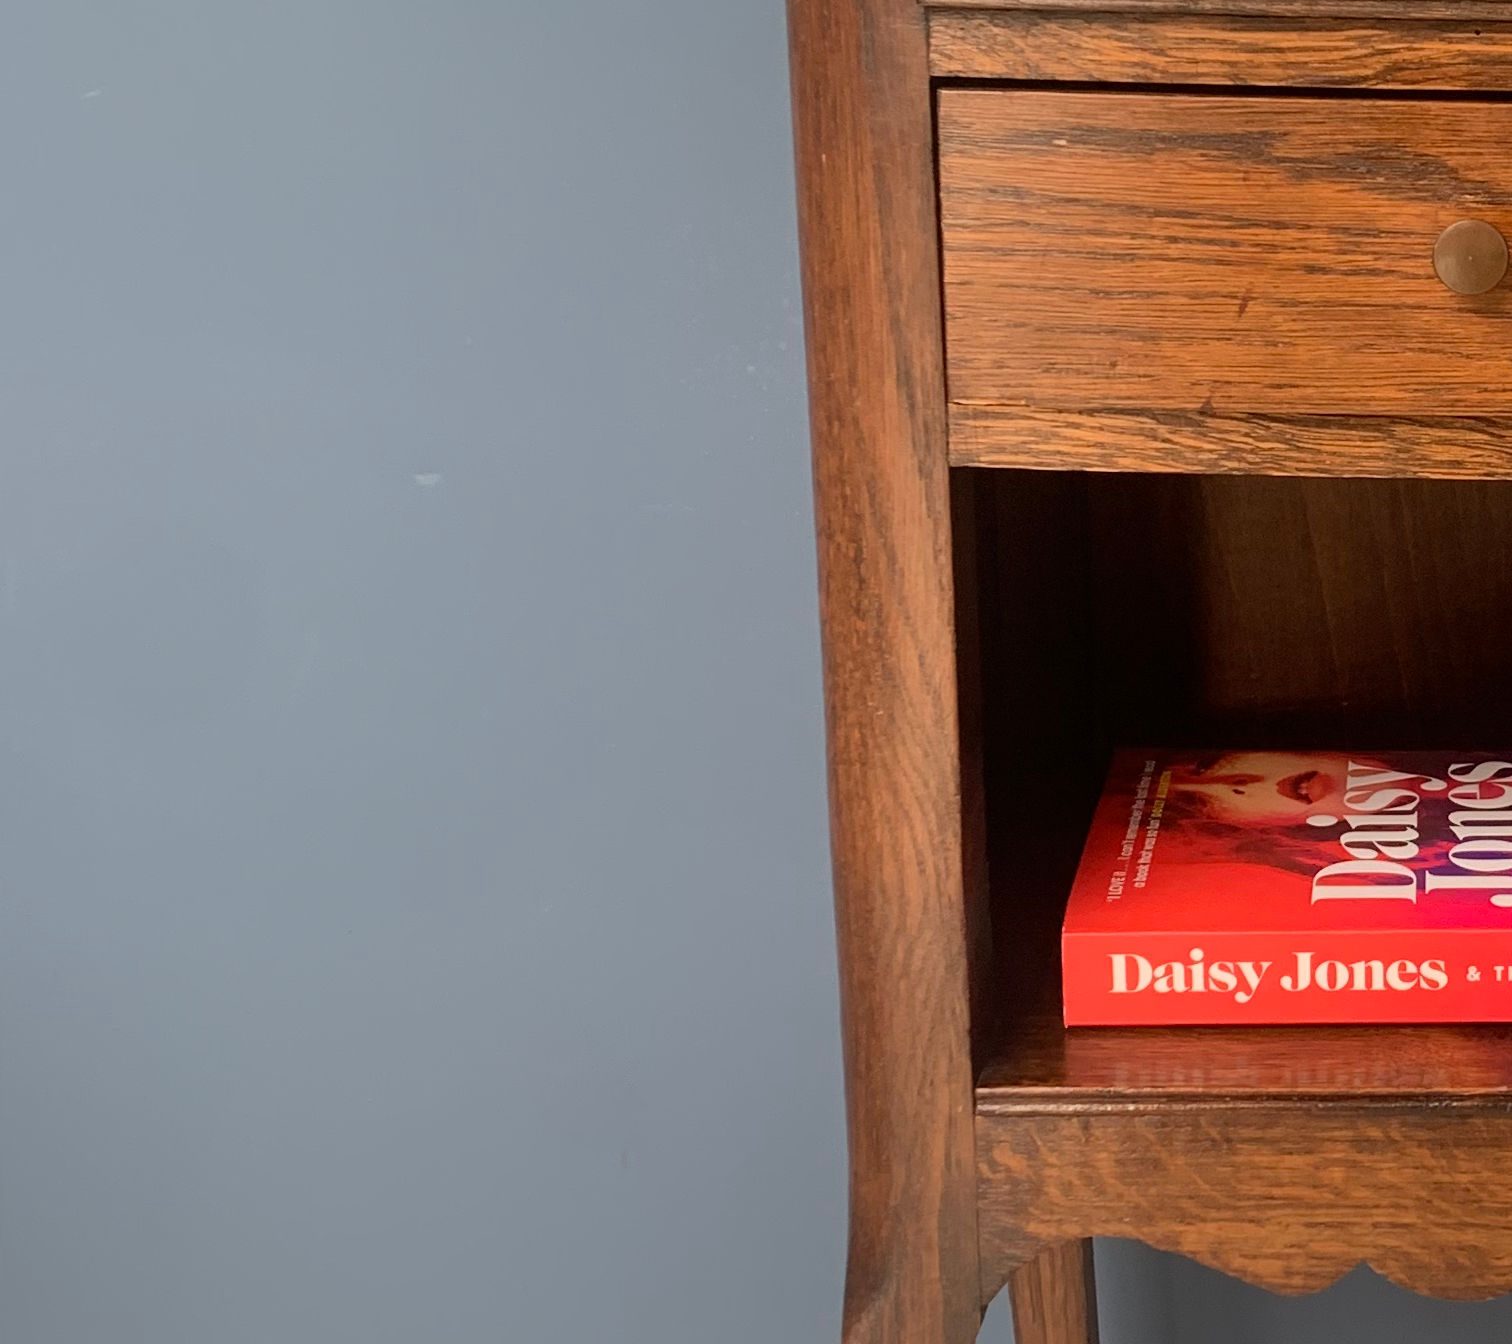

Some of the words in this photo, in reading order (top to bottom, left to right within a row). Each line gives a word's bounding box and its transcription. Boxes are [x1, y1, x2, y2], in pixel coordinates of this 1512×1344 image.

[1306, 760, 1448, 905] Daisy
[1108, 948, 1273, 1003] Daisy
[1280, 952, 1448, 992] Jones
[1466, 965, 1481, 981] &
